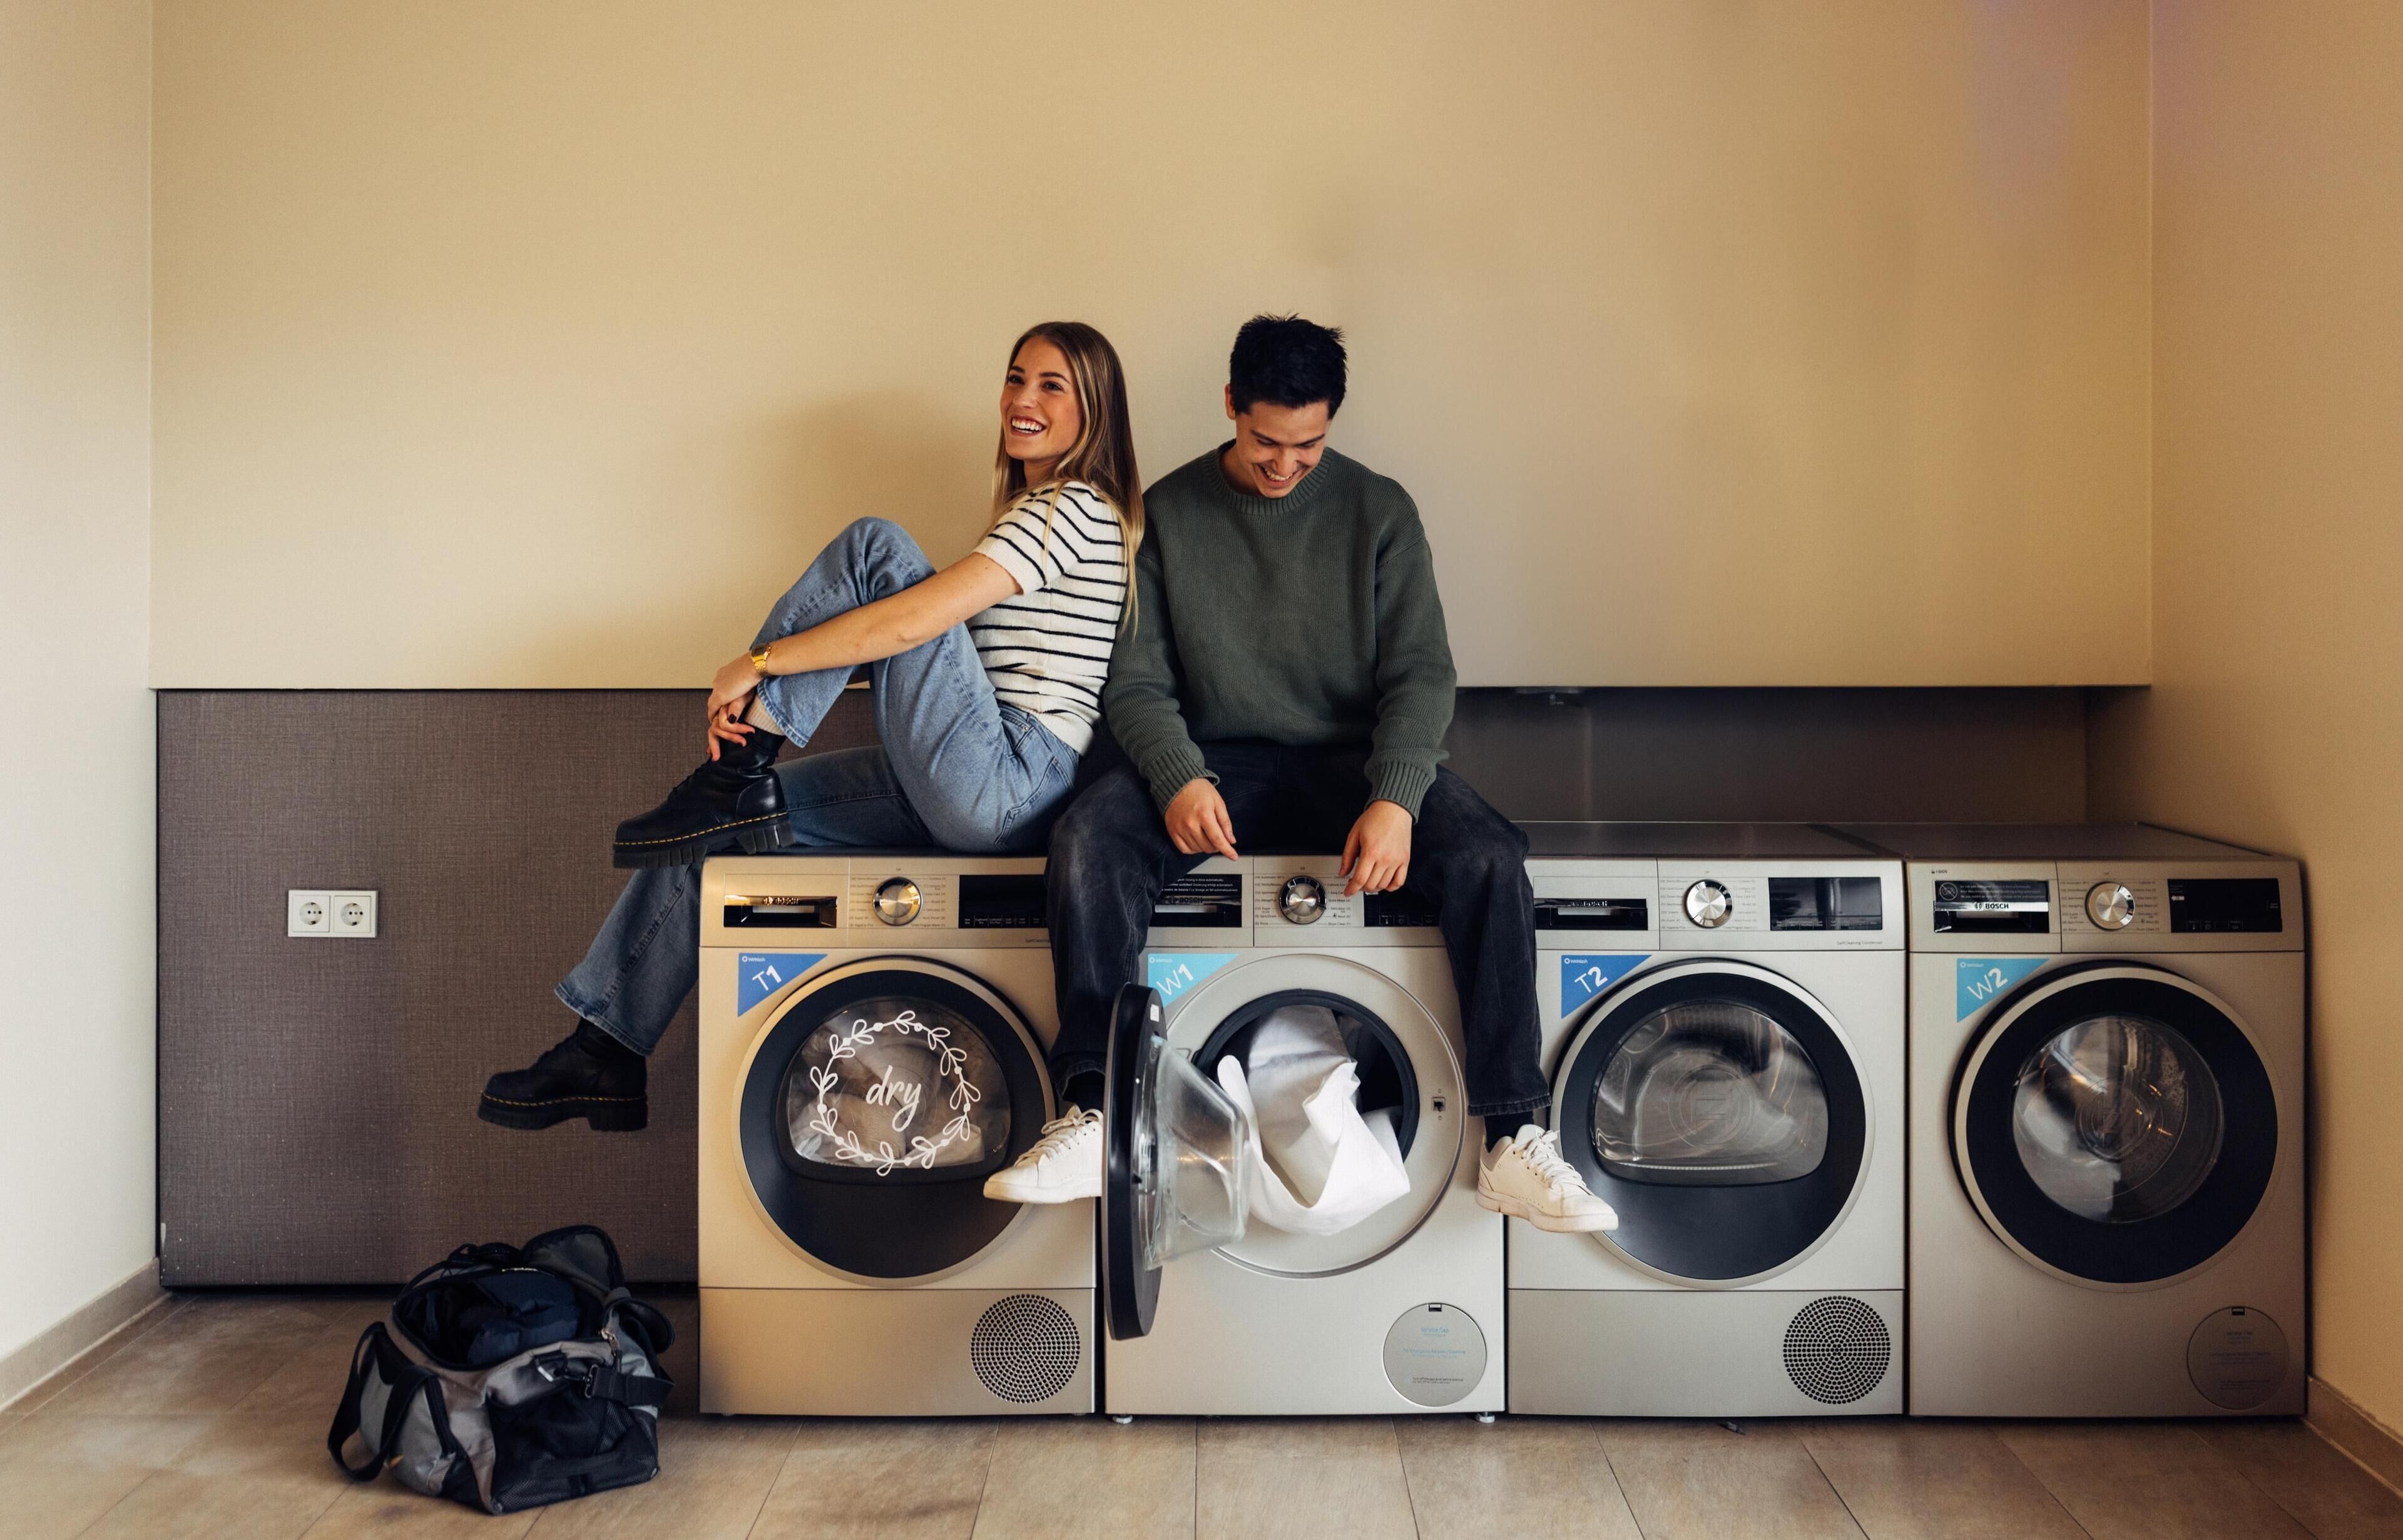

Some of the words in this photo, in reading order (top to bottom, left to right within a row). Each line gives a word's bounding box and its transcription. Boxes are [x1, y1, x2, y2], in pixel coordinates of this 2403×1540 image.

[752, 964, 782, 991] T1
[1156, 963, 1194, 996] W1
[1574, 966, 1608, 993] T2
[1967, 967, 2008, 1000] W2
[865, 1065, 922, 1133] dry
